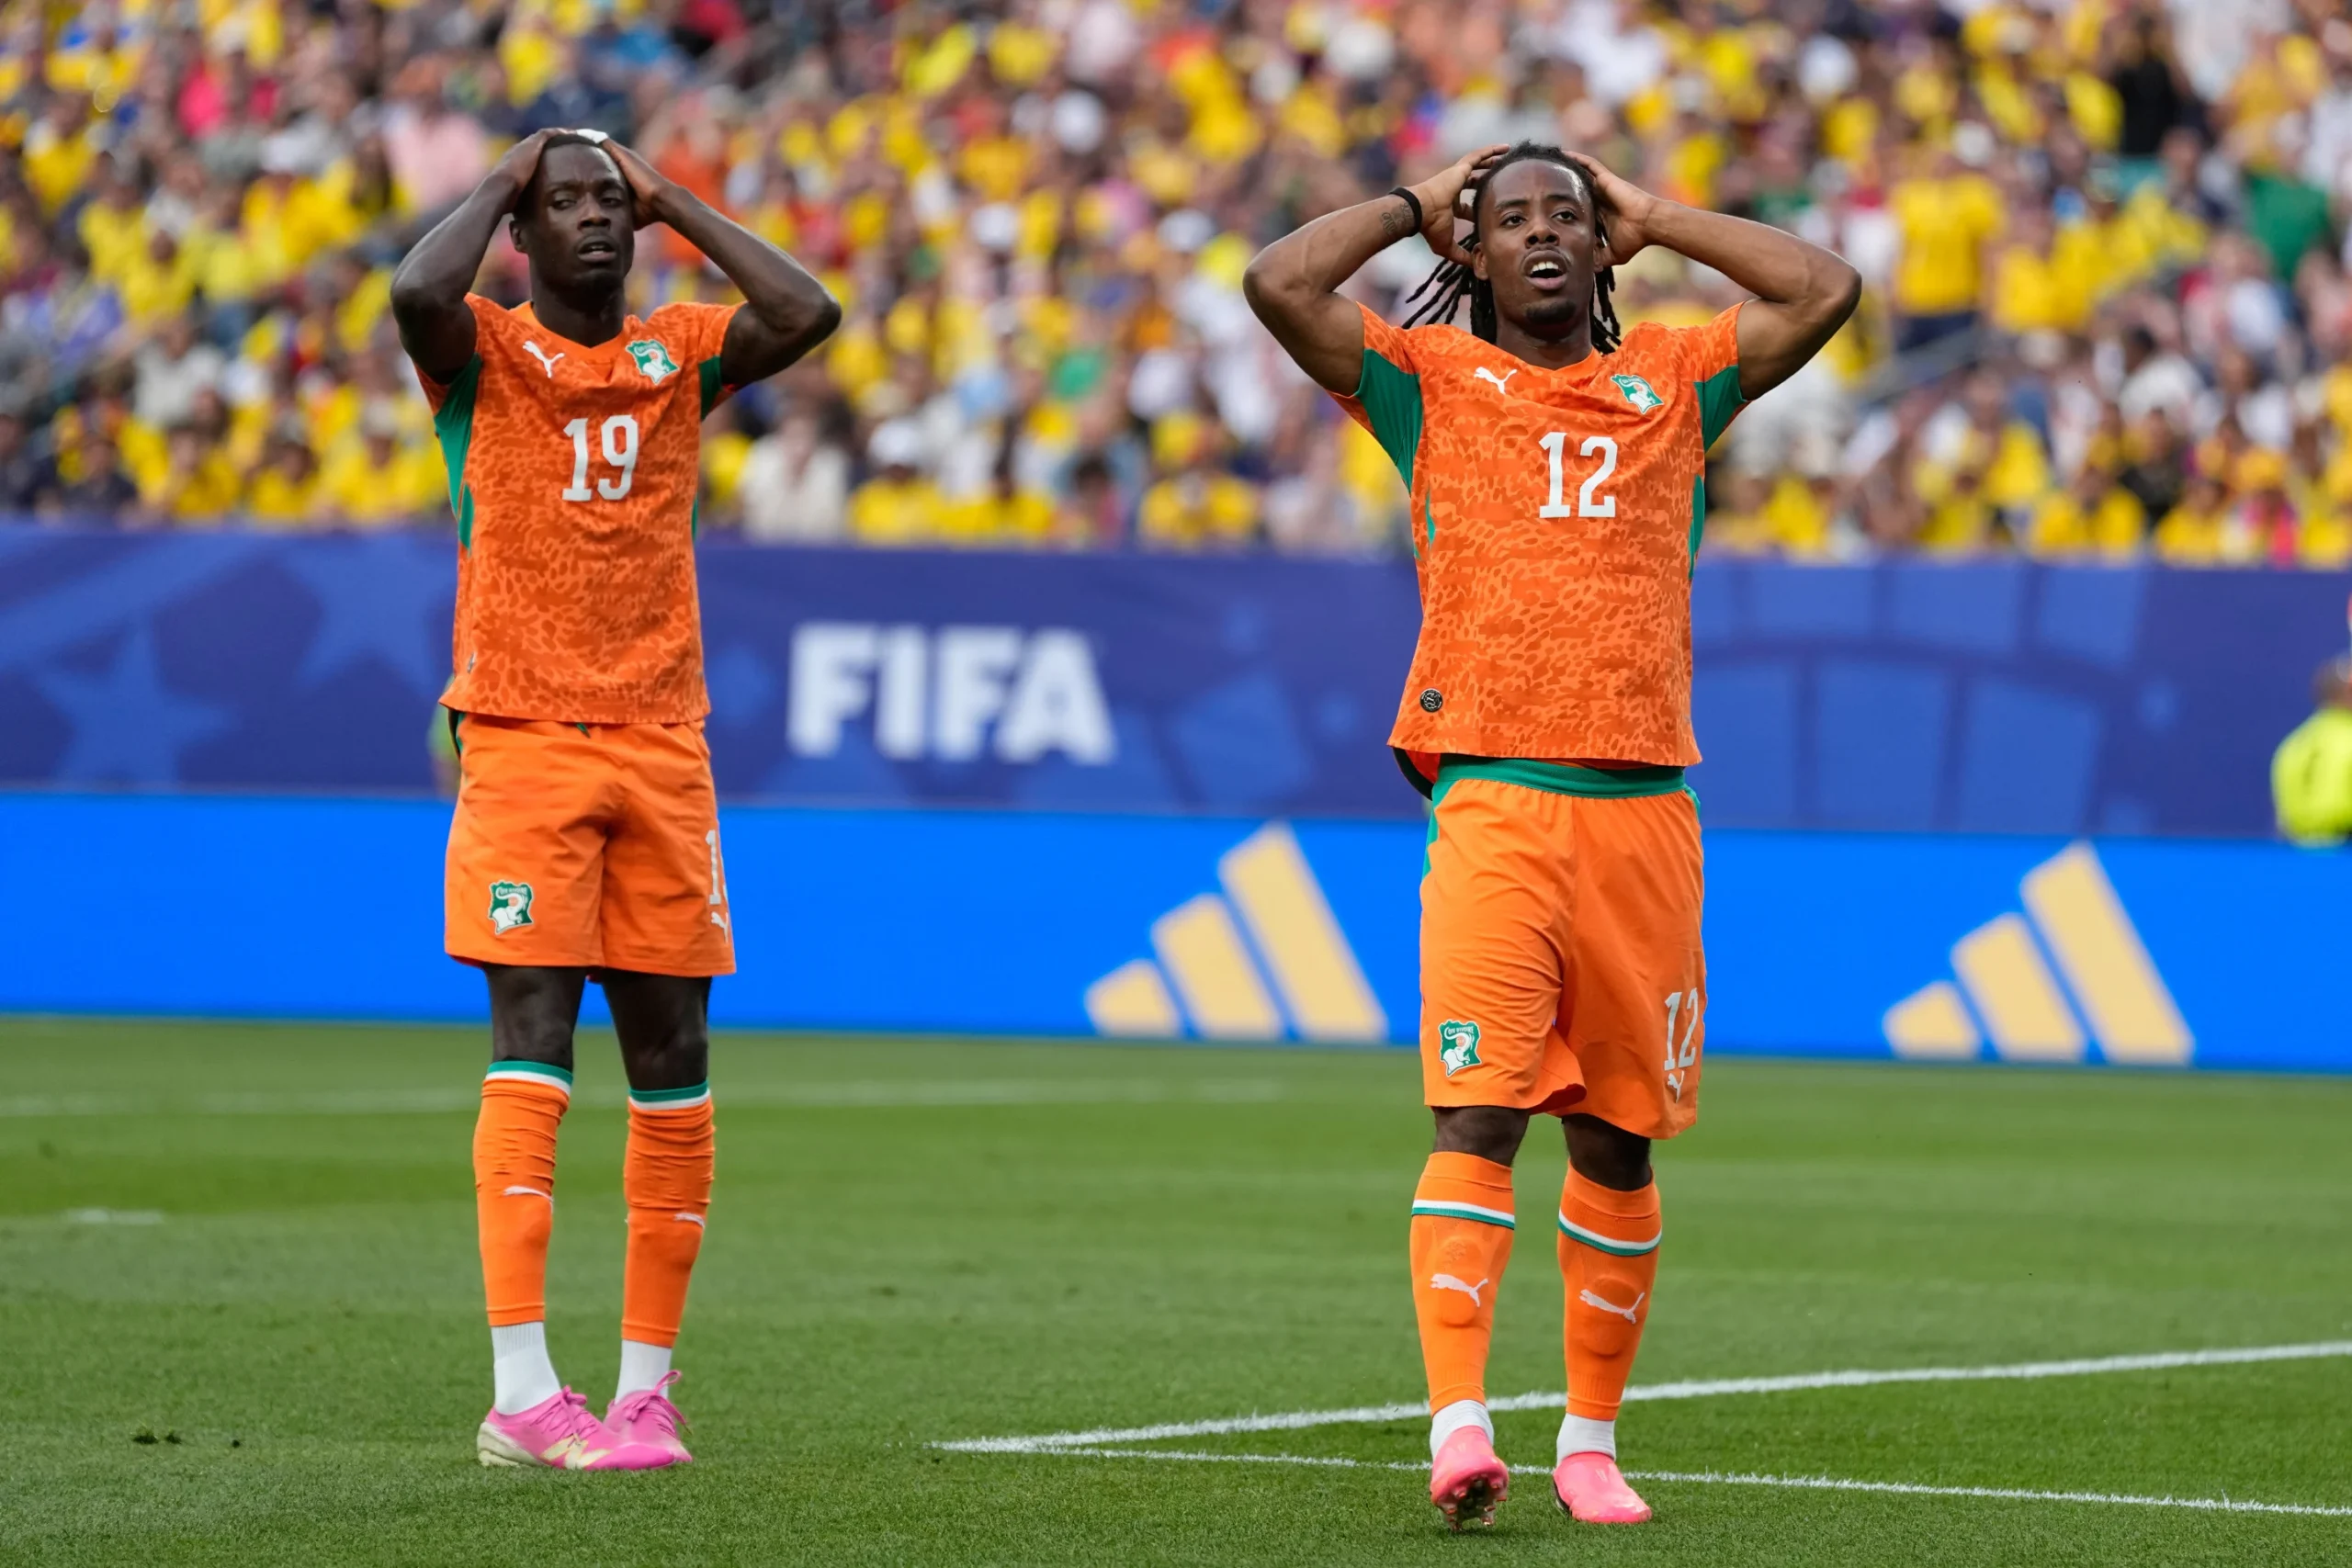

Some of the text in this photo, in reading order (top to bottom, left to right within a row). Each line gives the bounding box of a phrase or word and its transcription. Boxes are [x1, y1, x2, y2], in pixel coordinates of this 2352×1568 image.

[562, 415, 639, 502] 19
[1539, 432, 1618, 518] 12
[789, 624, 1114, 763] FIFA
[706, 829, 728, 905] 1
[1664, 987, 1698, 1070] 12
